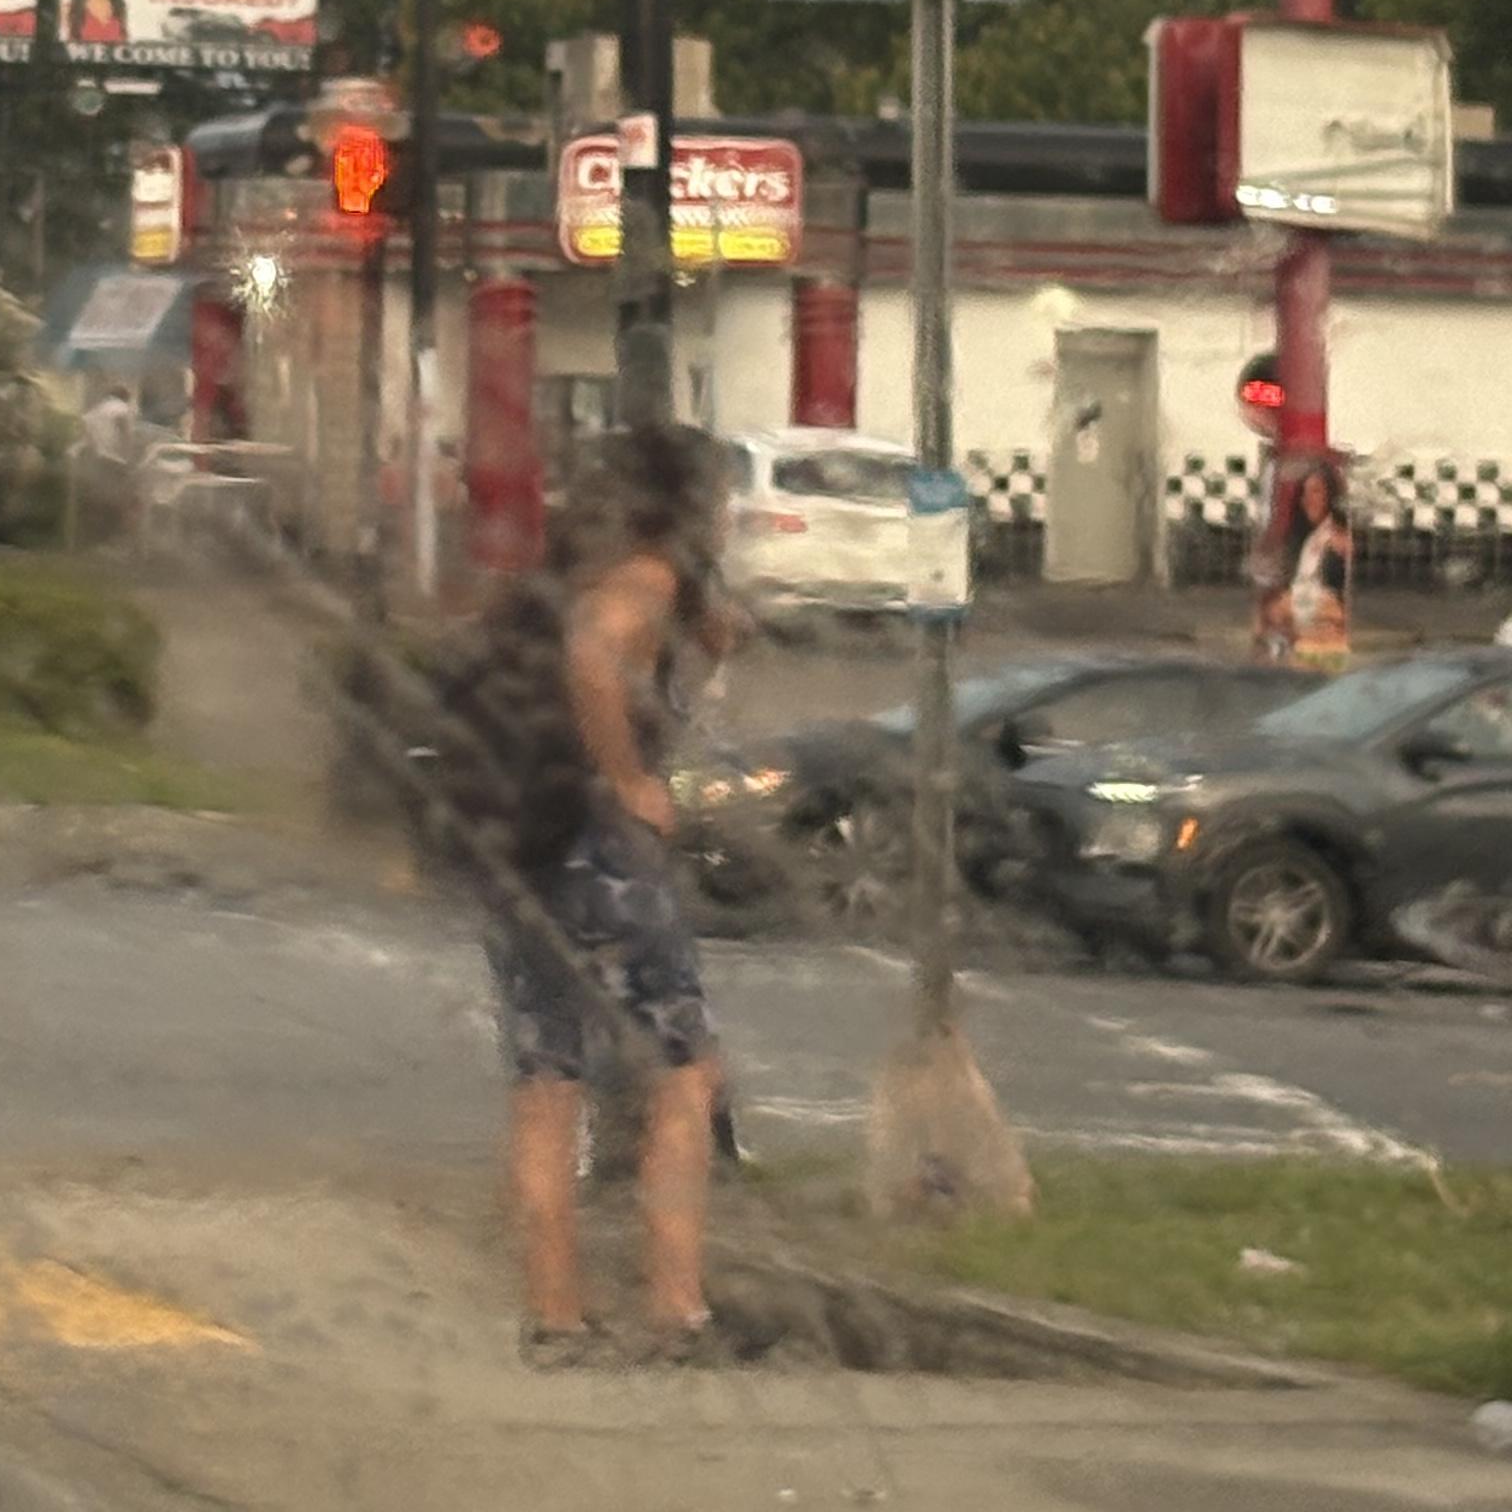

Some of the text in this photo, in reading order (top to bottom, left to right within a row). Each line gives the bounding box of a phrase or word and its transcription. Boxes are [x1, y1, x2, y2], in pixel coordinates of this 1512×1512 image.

[65, 43, 108, 63] WE
[113, 44, 195, 66] COME
[200, 46, 239, 68] TO
